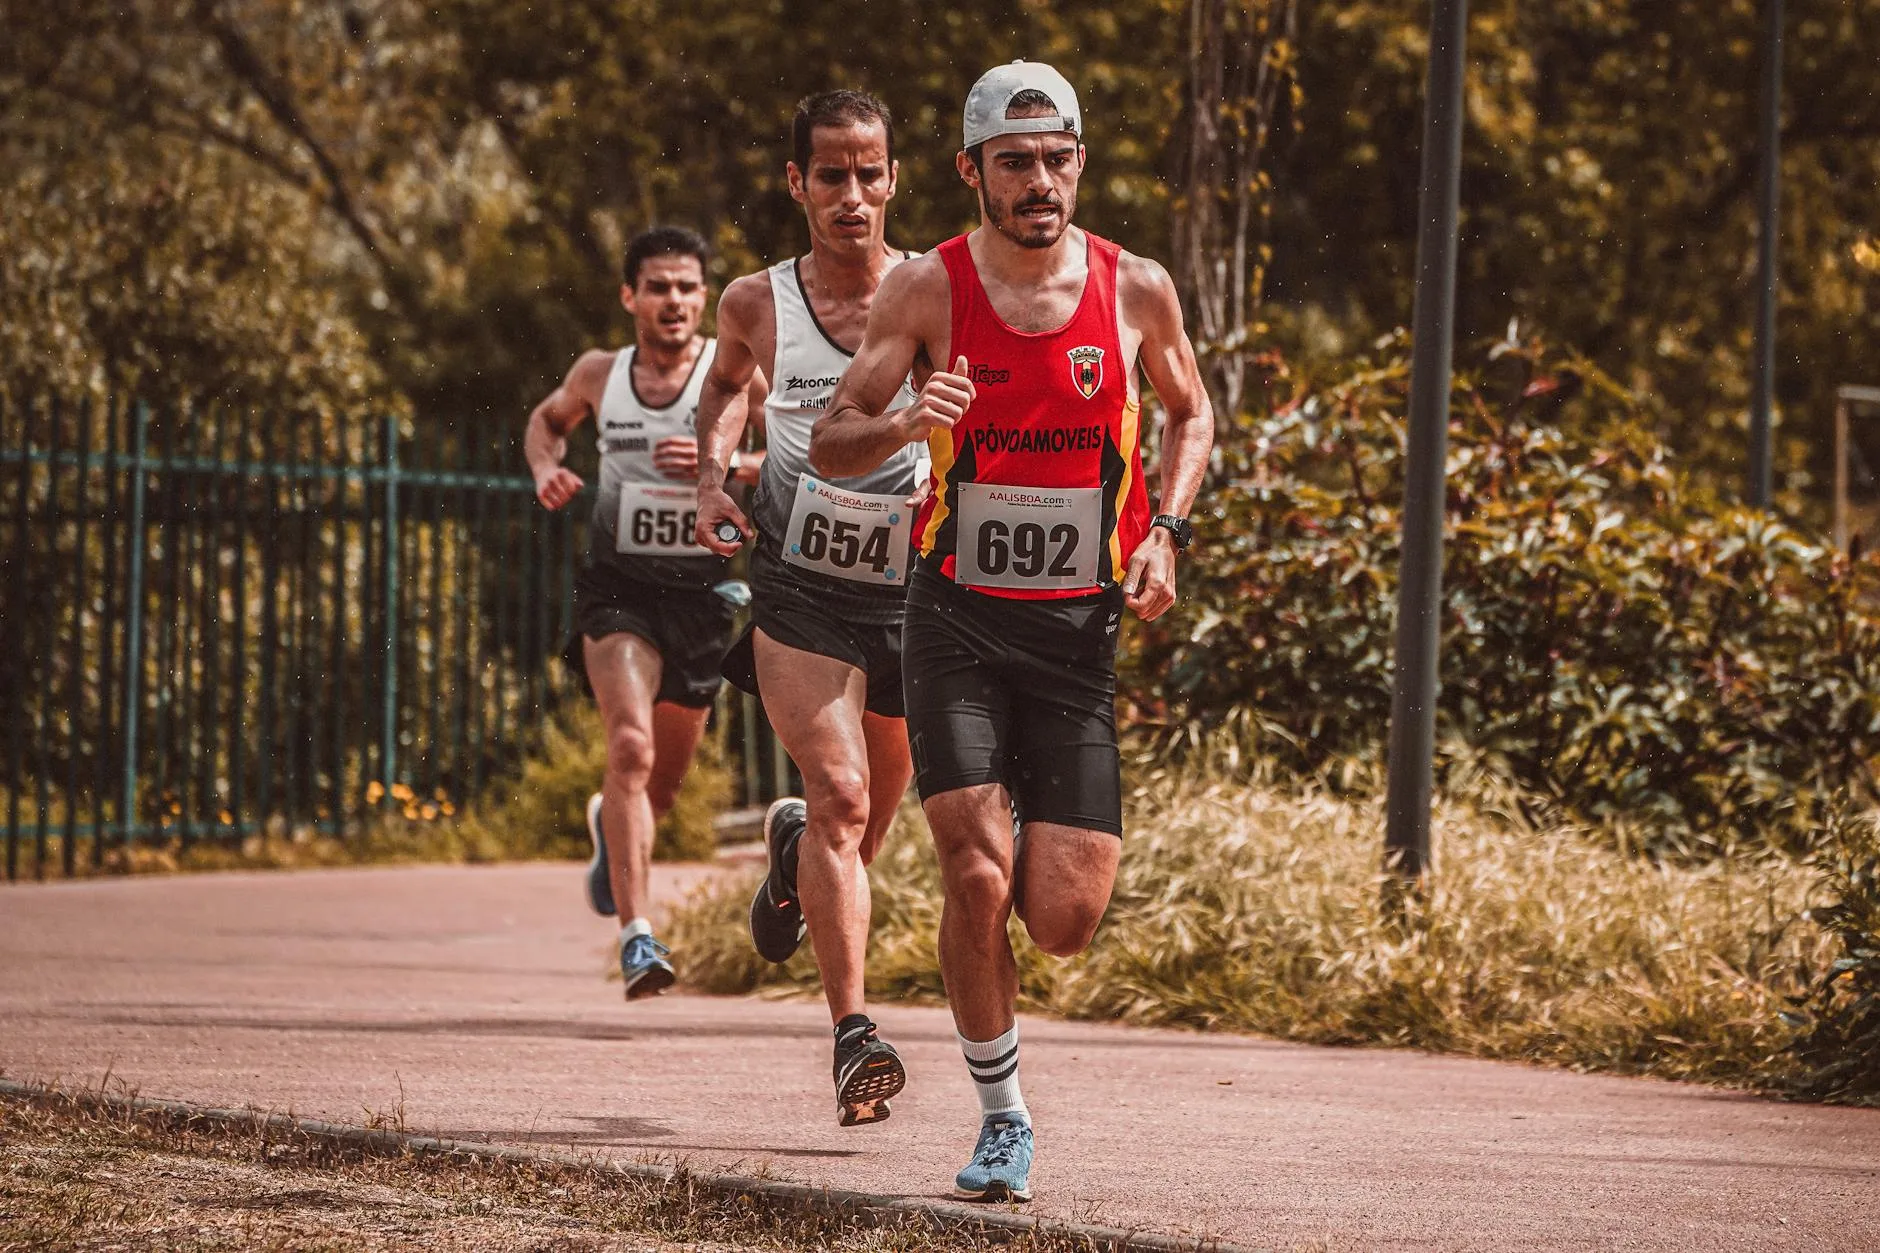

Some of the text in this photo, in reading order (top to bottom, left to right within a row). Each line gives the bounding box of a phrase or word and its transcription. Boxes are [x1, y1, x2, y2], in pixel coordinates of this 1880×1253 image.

[818, 489, 882, 509] AALISBOA.com
[988, 492, 1064, 504] AALISBOA.com
[631, 508, 697, 547] 658
[800, 512, 891, 573] 654
[977, 519, 1080, 577] 692
